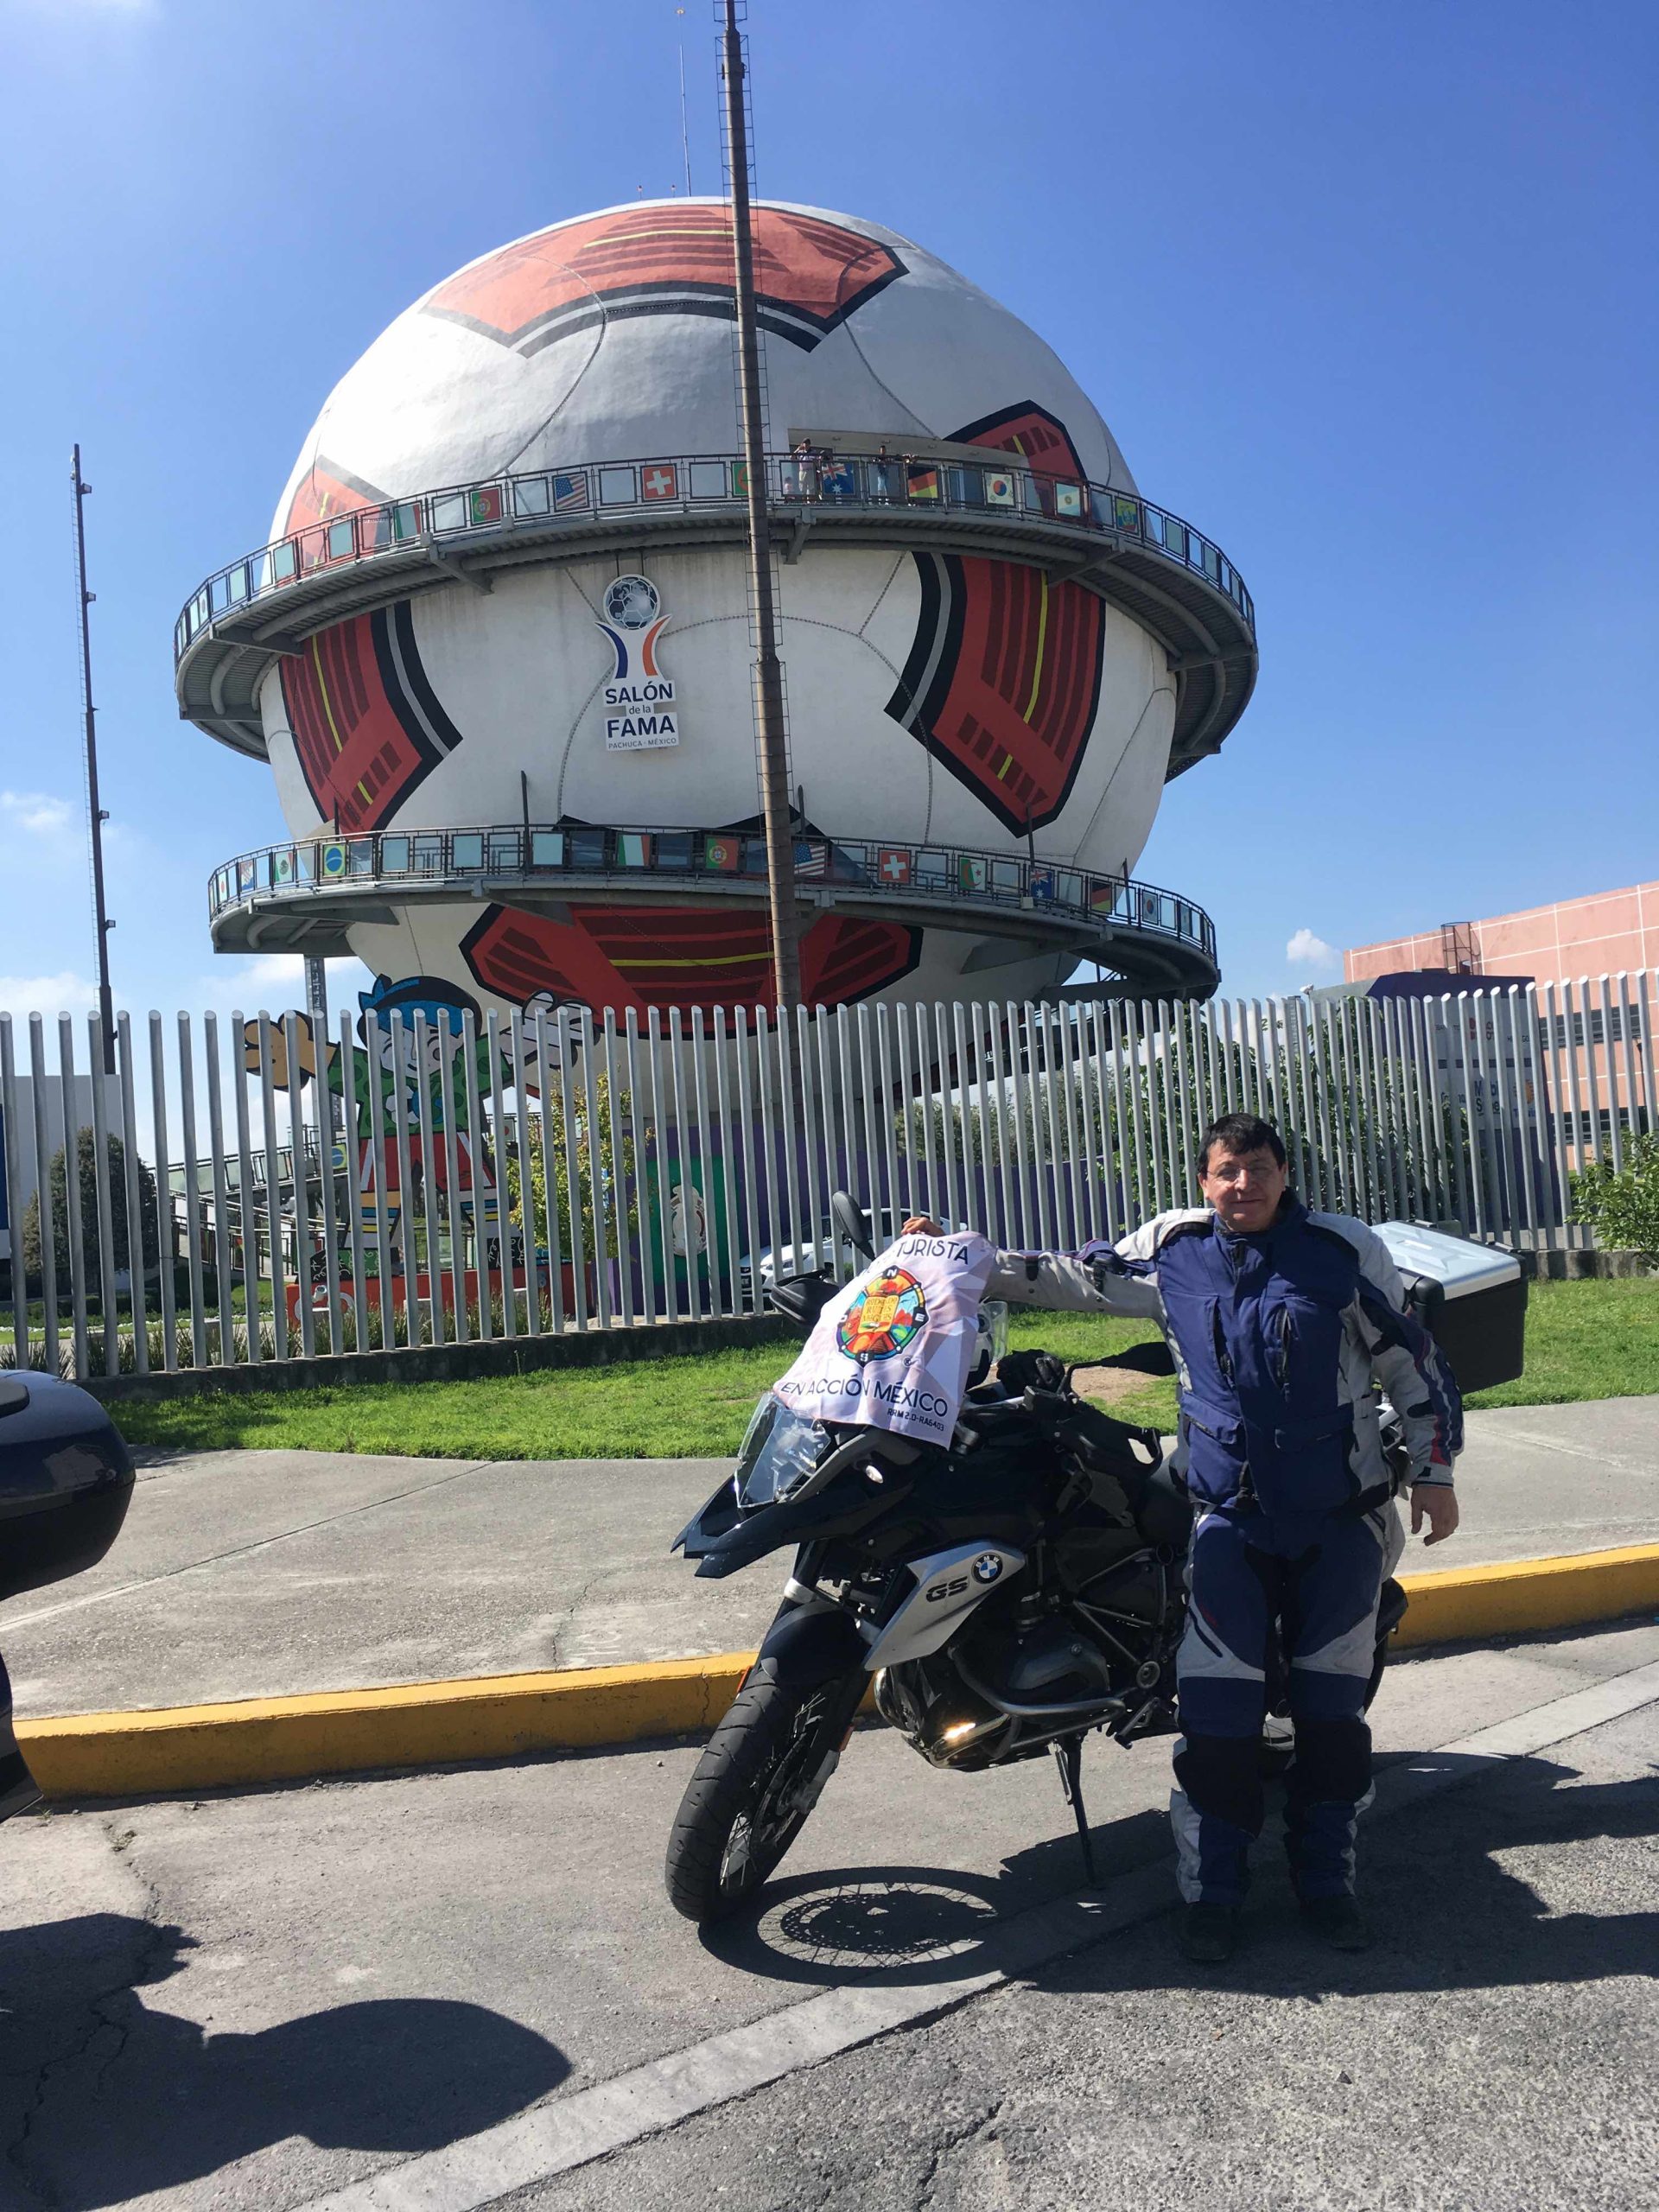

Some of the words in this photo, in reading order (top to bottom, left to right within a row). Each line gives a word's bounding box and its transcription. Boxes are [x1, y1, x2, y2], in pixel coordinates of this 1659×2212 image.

[605, 681, 673, 704] SALÓN
[628, 706, 641, 715] de
[643, 705, 652, 714] la
[607, 715, 676, 739] FAMA
[608, 741, 643, 749] PACHUCA
[647, 738, 677, 747] MÉXICO
[897, 1238, 969, 1265] TURISTA
[887, 1268, 898, 1277] N
[915, 1313, 925, 1322] E
[860, 1352, 869, 1362] S
[780, 1382, 805, 1395] EN
[807, 1374, 871, 1396] ACCIÓN
[874, 1381, 948, 1417] MÉXICO
[887, 1408, 905, 1418] RRM
[925, 1575, 969, 1603] GS
